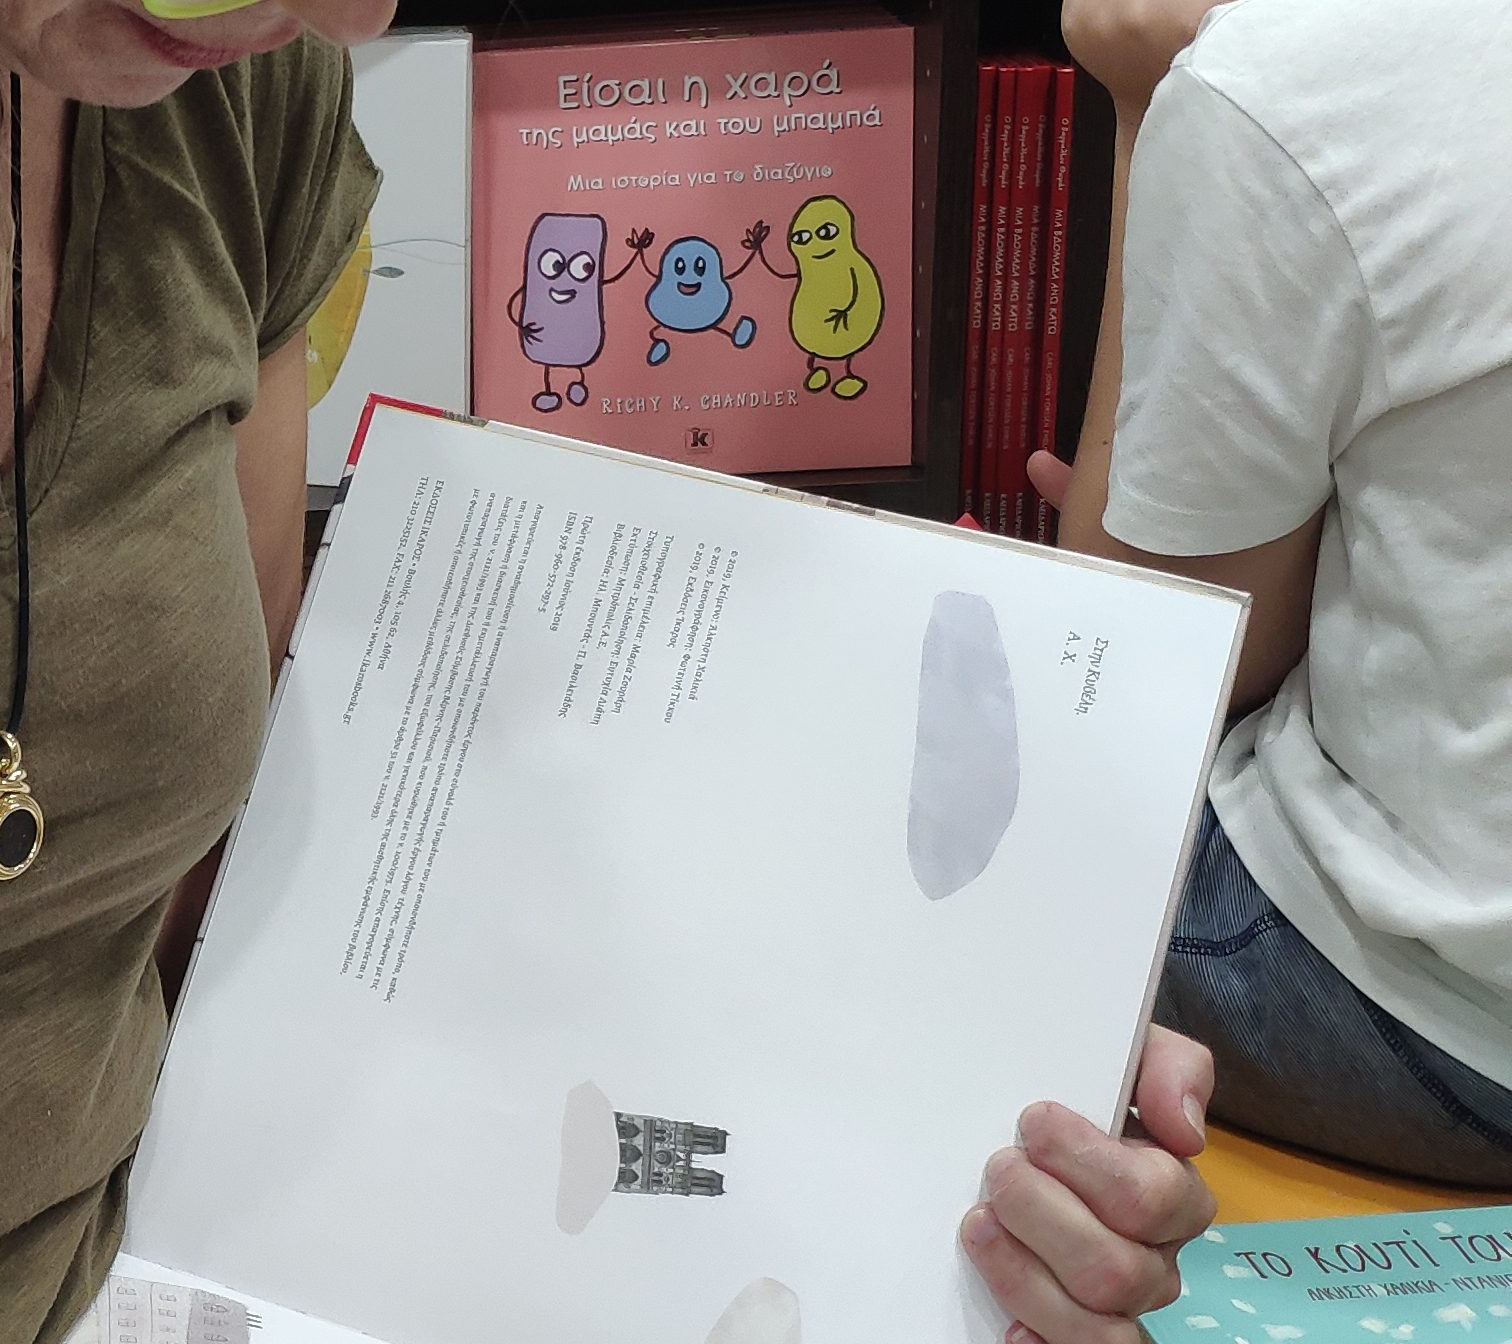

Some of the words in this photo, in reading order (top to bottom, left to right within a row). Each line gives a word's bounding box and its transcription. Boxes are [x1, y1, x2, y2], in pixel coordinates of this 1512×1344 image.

[556, 72, 667, 110] Είσαι
[683, 74, 709, 108] η
[724, 58, 842, 106] χαρά
[518, 123, 563, 149] της
[572, 116, 657, 147] μαμάς
[665, 117, 707, 139] και
[716, 114, 762, 136] του
[772, 104, 883, 137] μπαμπά
[567, 174, 604, 192] Μια
[612, 169, 681, 190] ιστορία
[687, 169, 717, 188] για
[723, 169, 745, 184] το
[752, 162, 834, 185] διαζύγιο
[997, 206, 1006, 224] ΜΙΑ
[1054, 209, 1063, 227] ΜΙΑ
[994, 228, 1006, 276] ΒΔΟΜΑΔΑ
[1051, 230, 1062, 279] ΒΔΟΜΑΔΑ
[993, 279, 1002, 300] ΑΝΩ
[1049, 282, 1059, 304] ΑΝΩ
[991, 303, 1001, 330] ΚΑΤΩ
[1047, 307, 1058, 335] ΚΑΤΩ
[673, 395, 691, 411] K.
[700, 389, 799, 410] CHANDLER
[414, 476, 429, 499] ΤΗΛ:
[423, 479, 444, 526] ΕΚΔΟΣΕΙΣ
[563, 511, 578, 534] ISBN
[575, 515, 594, 545] Πρώτη
[411, 526, 430, 562] ΙΚΑΡΟΣ
[565, 546, 584, 577] έκδοση
[632, 530, 658, 590] Στοιχειοθεσία
[646, 535, 674, 594] Τυπογραφική
[688, 550, 703, 573] 2019,
[705, 554, 720, 577] 2019,
[721, 558, 736, 581] 2019,
[398, 568, 416, 600] Βουλής
[676, 575, 697, 615] Εκδόσεις
[633, 594, 655, 642] επιμέλεια:
[683, 579, 714, 651] Εικονογράφηση:
[710, 583, 730, 622] Κείμενο:
[549, 611, 563, 631] 2019
[610, 596, 639, 658] Σελιδοποίηση:
[666, 616, 685, 648] Ίκαρος
[696, 624, 718, 663] Άλκηστη
[1065, 631, 1082, 647] Α.
[1088, 637, 1109, 668] Στην
[377, 641, 392, 670] Αθήνα
[624, 643, 641, 674] Μαρία
[1060, 649, 1077, 666] Χ.
[600, 660, 619, 696] Ευτυχία
[671, 653, 691, 691] Φωτεινή
[687, 664, 706, 700] Χαλικιά
[663, 692, 680, 723] Τίκκου
[1234, 1251, 1292, 1279] ΤΟ
